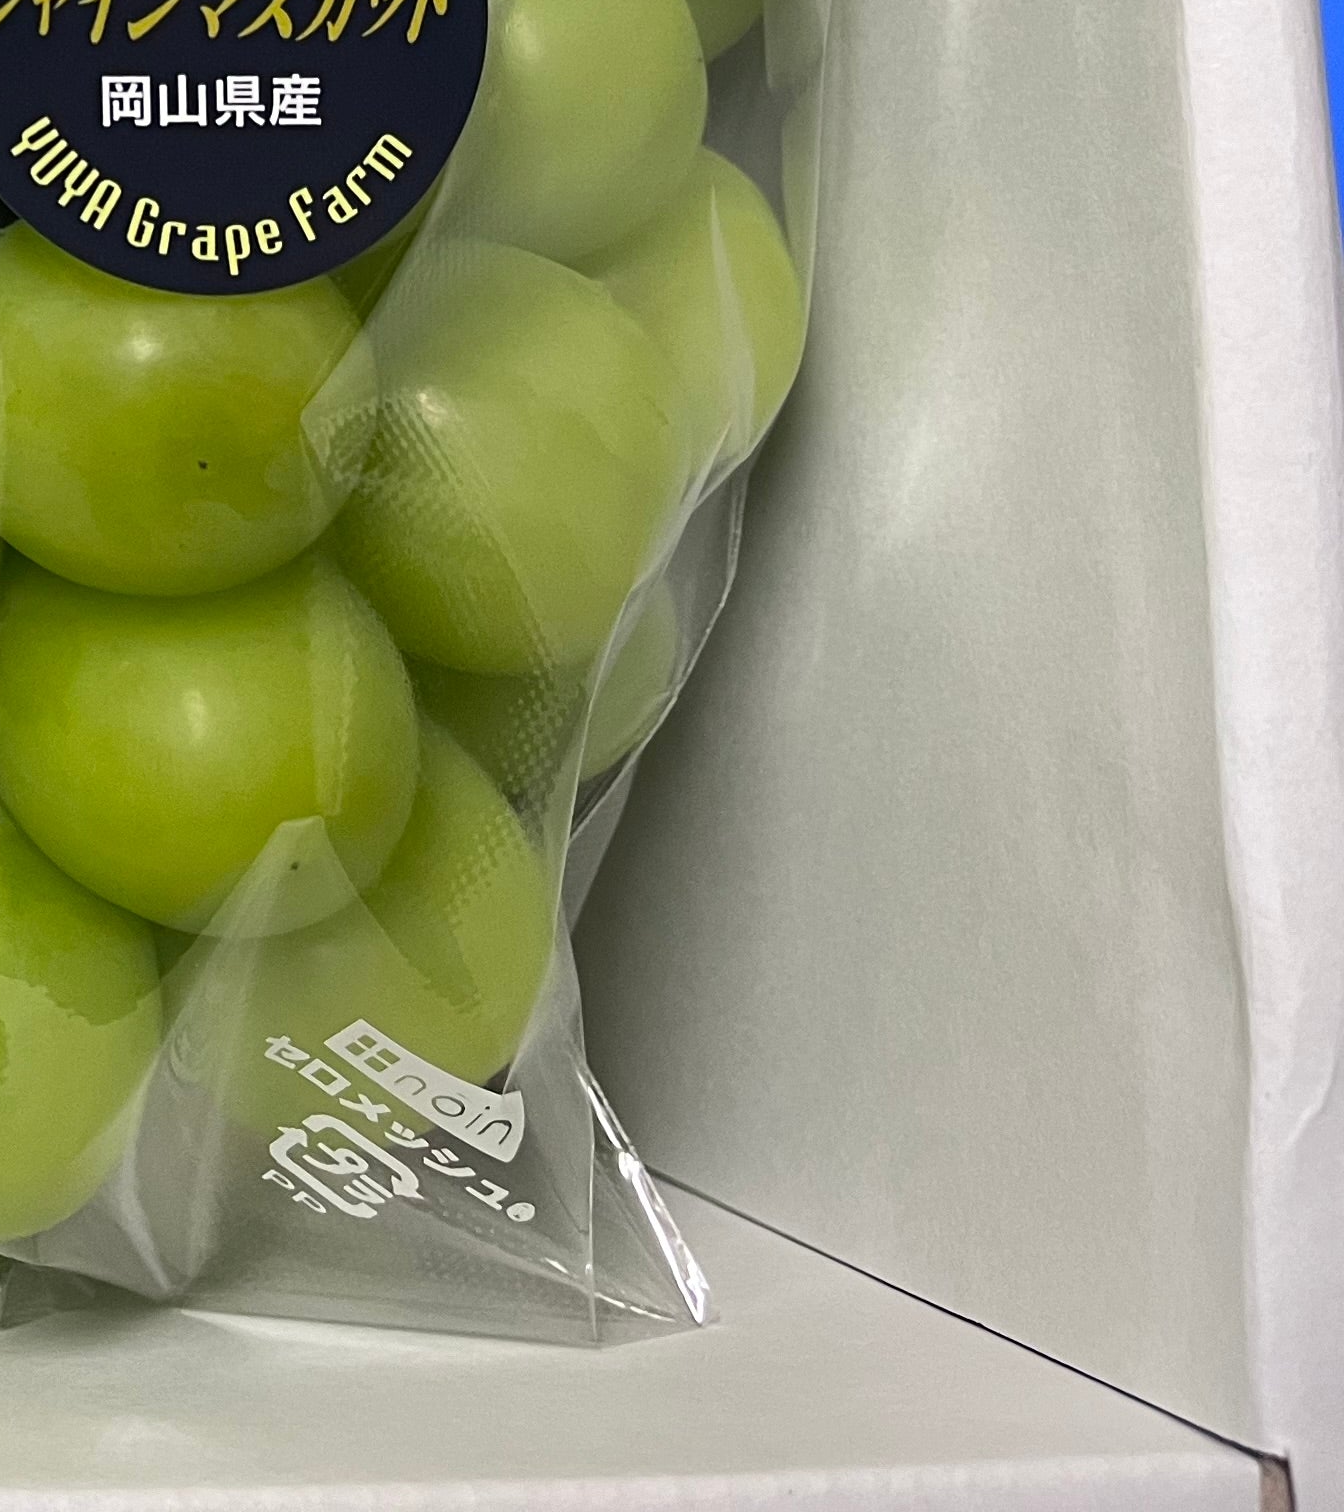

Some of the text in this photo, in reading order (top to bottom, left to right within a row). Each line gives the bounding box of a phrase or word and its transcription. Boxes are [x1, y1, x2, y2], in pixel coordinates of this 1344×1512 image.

[100, 74, 323, 128] 岡山県産
[10, 116, 413, 276] YUYA Grape Farm
[262, 1169, 327, 1214] PP
